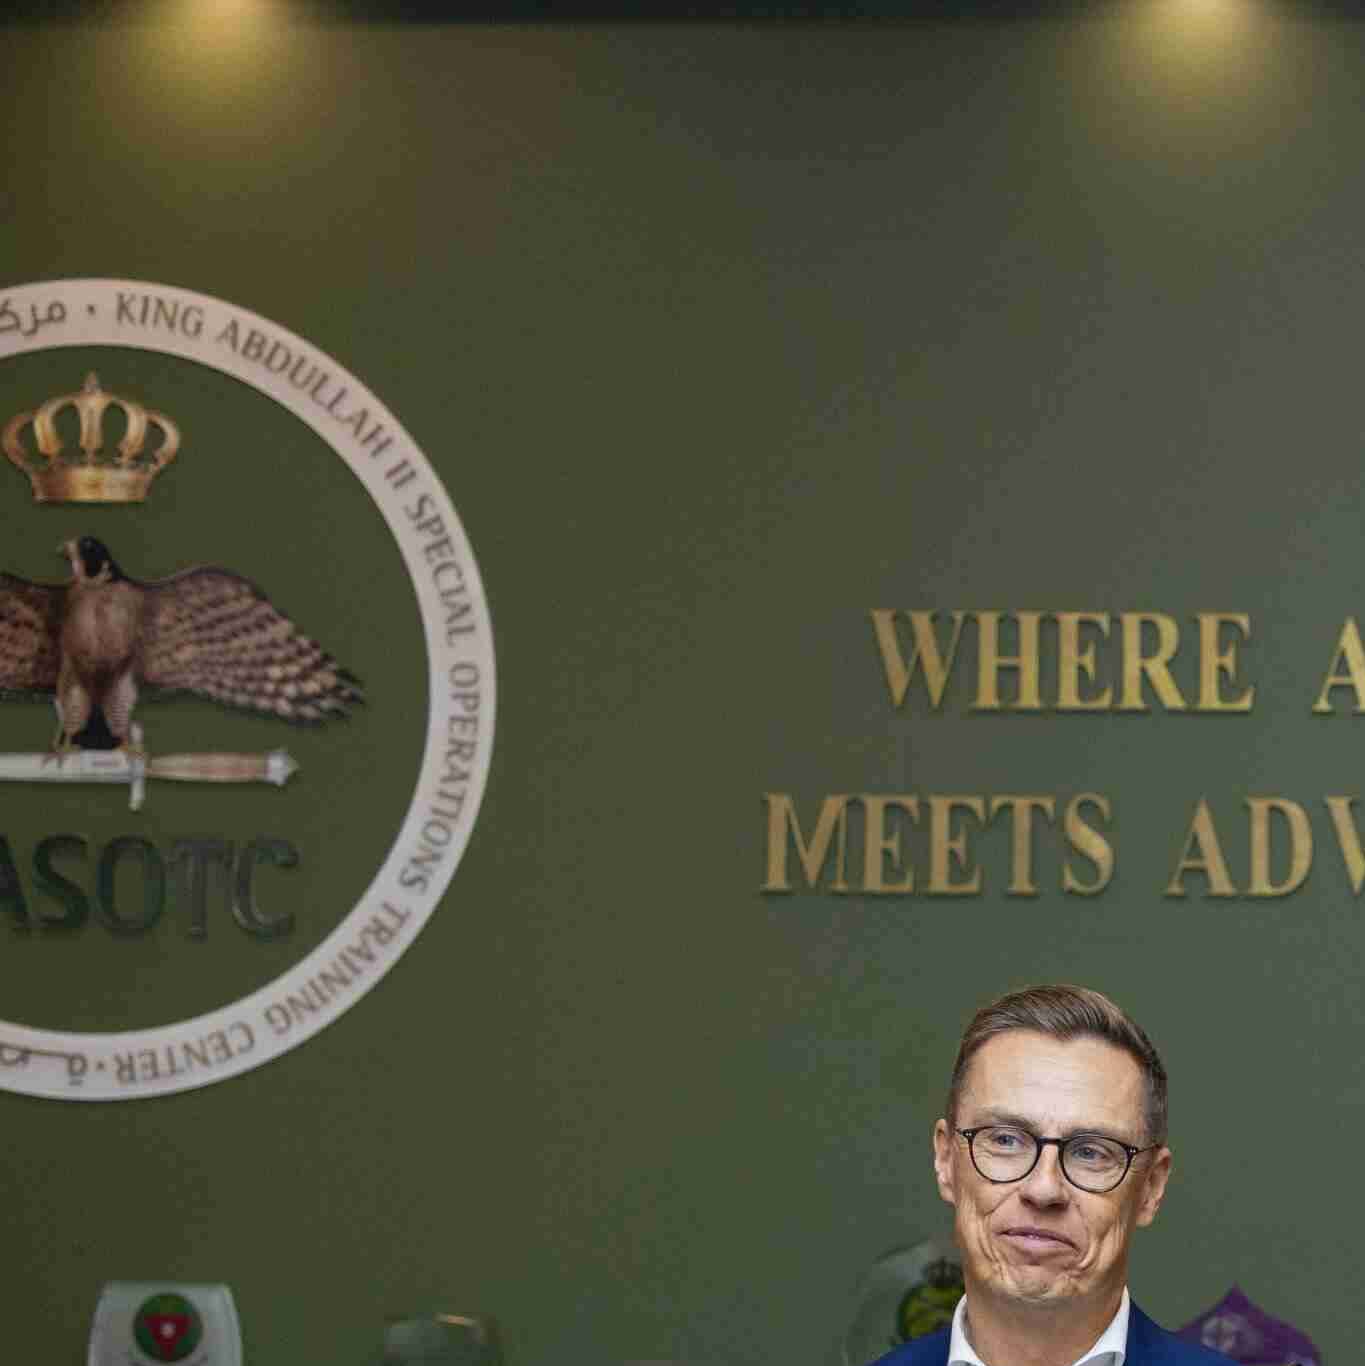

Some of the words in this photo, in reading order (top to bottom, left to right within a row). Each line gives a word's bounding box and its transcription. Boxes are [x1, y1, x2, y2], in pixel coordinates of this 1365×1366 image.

[0, 299, 67, 337] مرك
[115, 291, 206, 338] KING
[215, 318, 394, 459] ABDULLAH
[384, 458, 417, 489] II
[403, 493, 476, 648] SPECIAL
[870, 608, 1254, 712] WHERE
[399, 661, 481, 896] OPERATIONS
[0, 832, 301, 943] ASOTC
[760, 791, 1115, 897] MEETS
[263, 899, 413, 1036] TRAINING
[113, 1019, 256, 1085] CENTER
